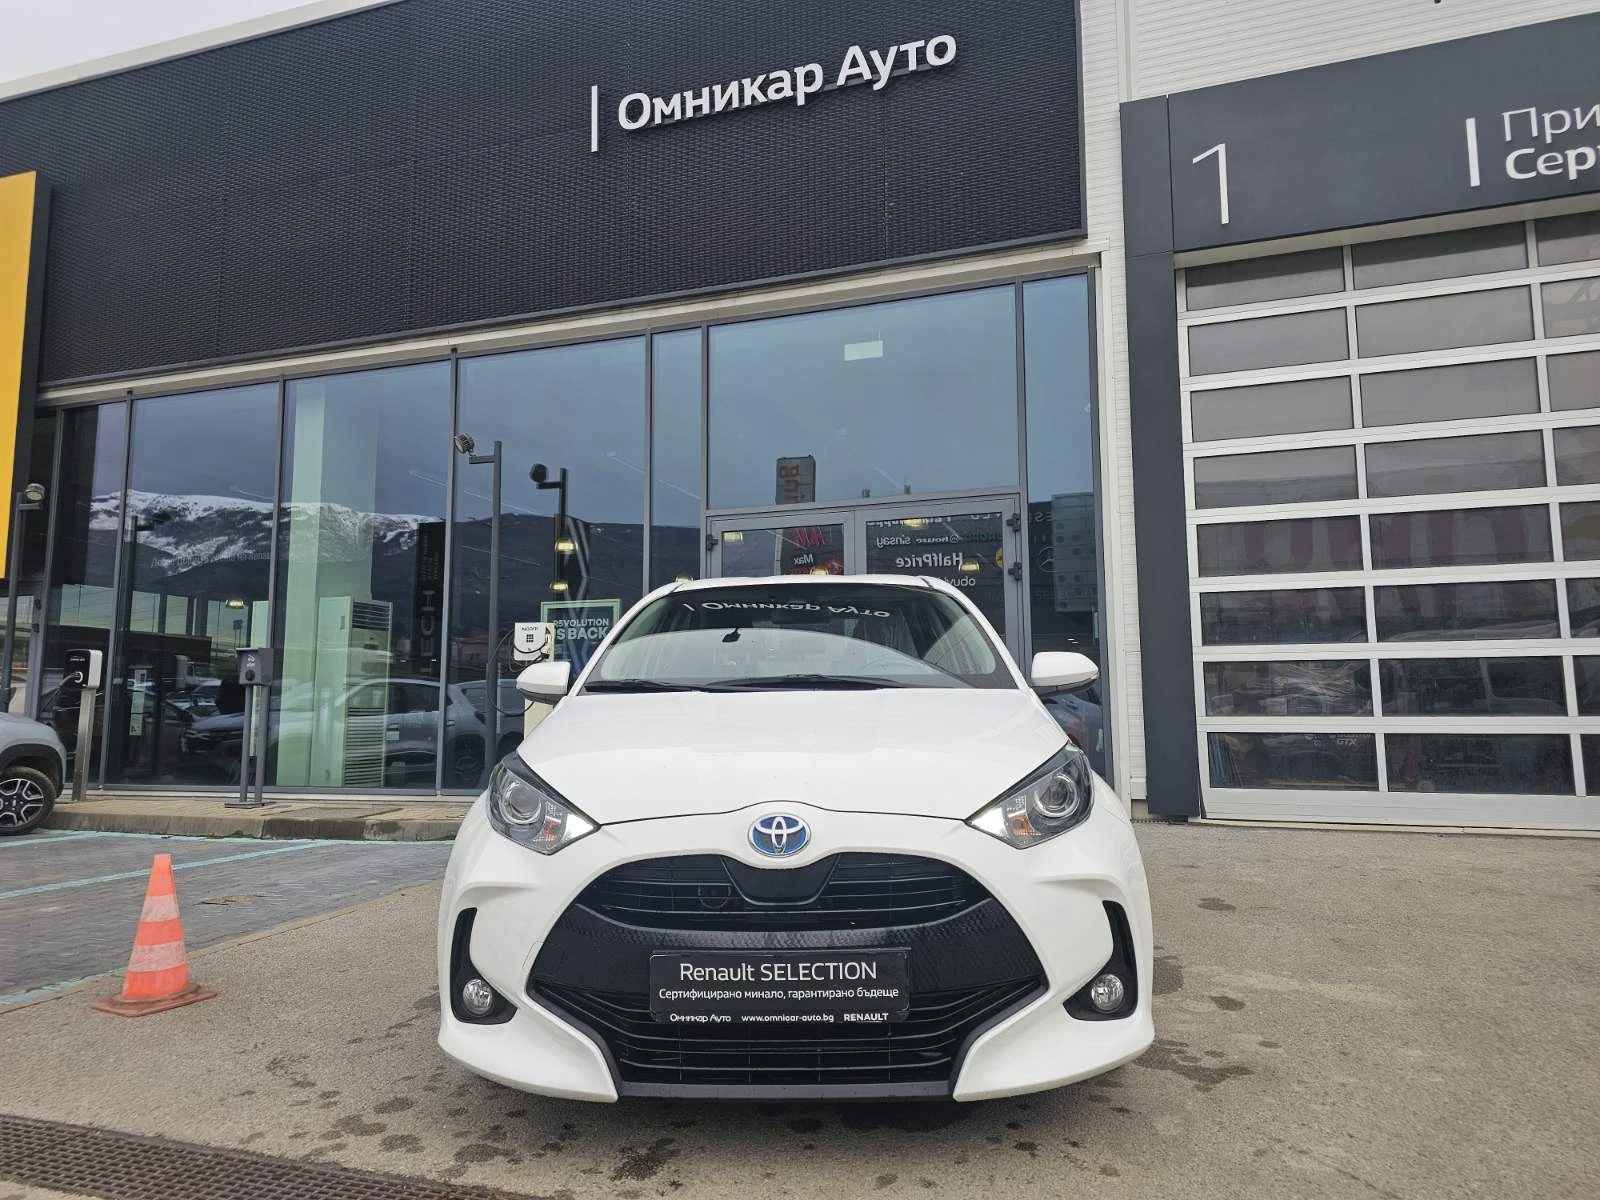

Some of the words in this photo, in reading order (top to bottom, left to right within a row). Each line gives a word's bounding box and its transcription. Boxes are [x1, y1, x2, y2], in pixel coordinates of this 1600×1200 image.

[617, 62, 824, 131] Омникар
[836, 34, 957, 91] Ауто
[1502, 104, 1600, 144] При
[1505, 145, 1600, 181] Сер
[1192, 143, 1230, 225] 1
[555, 628, 566, 640] S
[567, 626, 609, 640] BACK
[680, 963, 755, 981] Renault
[760, 962, 877, 981] SELECTION
[659, 988, 742, 1000] Сертифицирано
[744, 990, 786, 999] минало,
[788, 988, 854, 1000] гарантирано
[857, 987, 899, 998] бъдеще
[669, 1013, 709, 1023] Омникар
[710, 1014, 732, 1023] Ауто
[741, 1014, 834, 1022] www.omnicar-auto.bg
[843, 1013, 889, 1021] RENAULT
